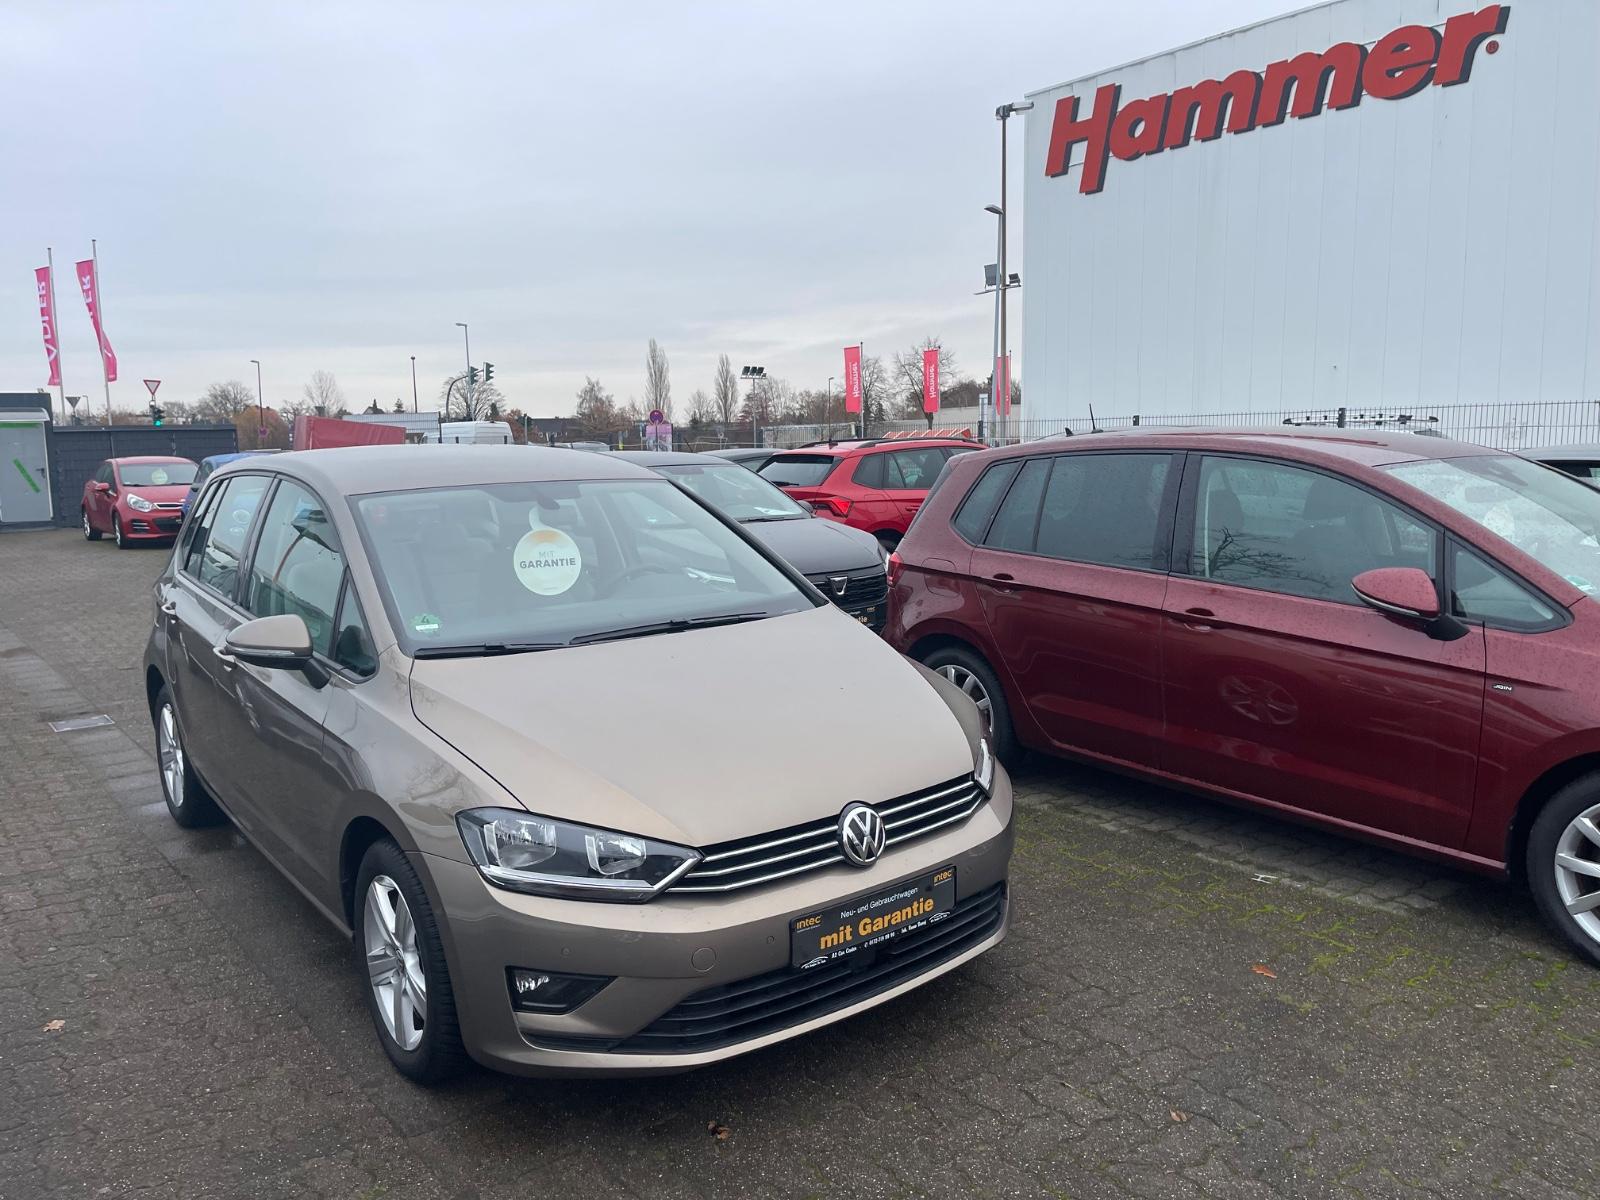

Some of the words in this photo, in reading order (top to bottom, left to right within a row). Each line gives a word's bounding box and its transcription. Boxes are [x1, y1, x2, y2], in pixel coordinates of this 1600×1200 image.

[1045, 4, 1510, 195] Hammer
[520, 557, 577, 569] GARANTIE
[934, 870, 953, 884] intec
[840, 909, 856, 919] Neu-
[857, 904, 869, 914] und
[869, 887, 918, 908] Gebrauchtwagen
[796, 915, 822, 929] intec
[820, 922, 853, 950] mit
[858, 898, 934, 936] Garantie
